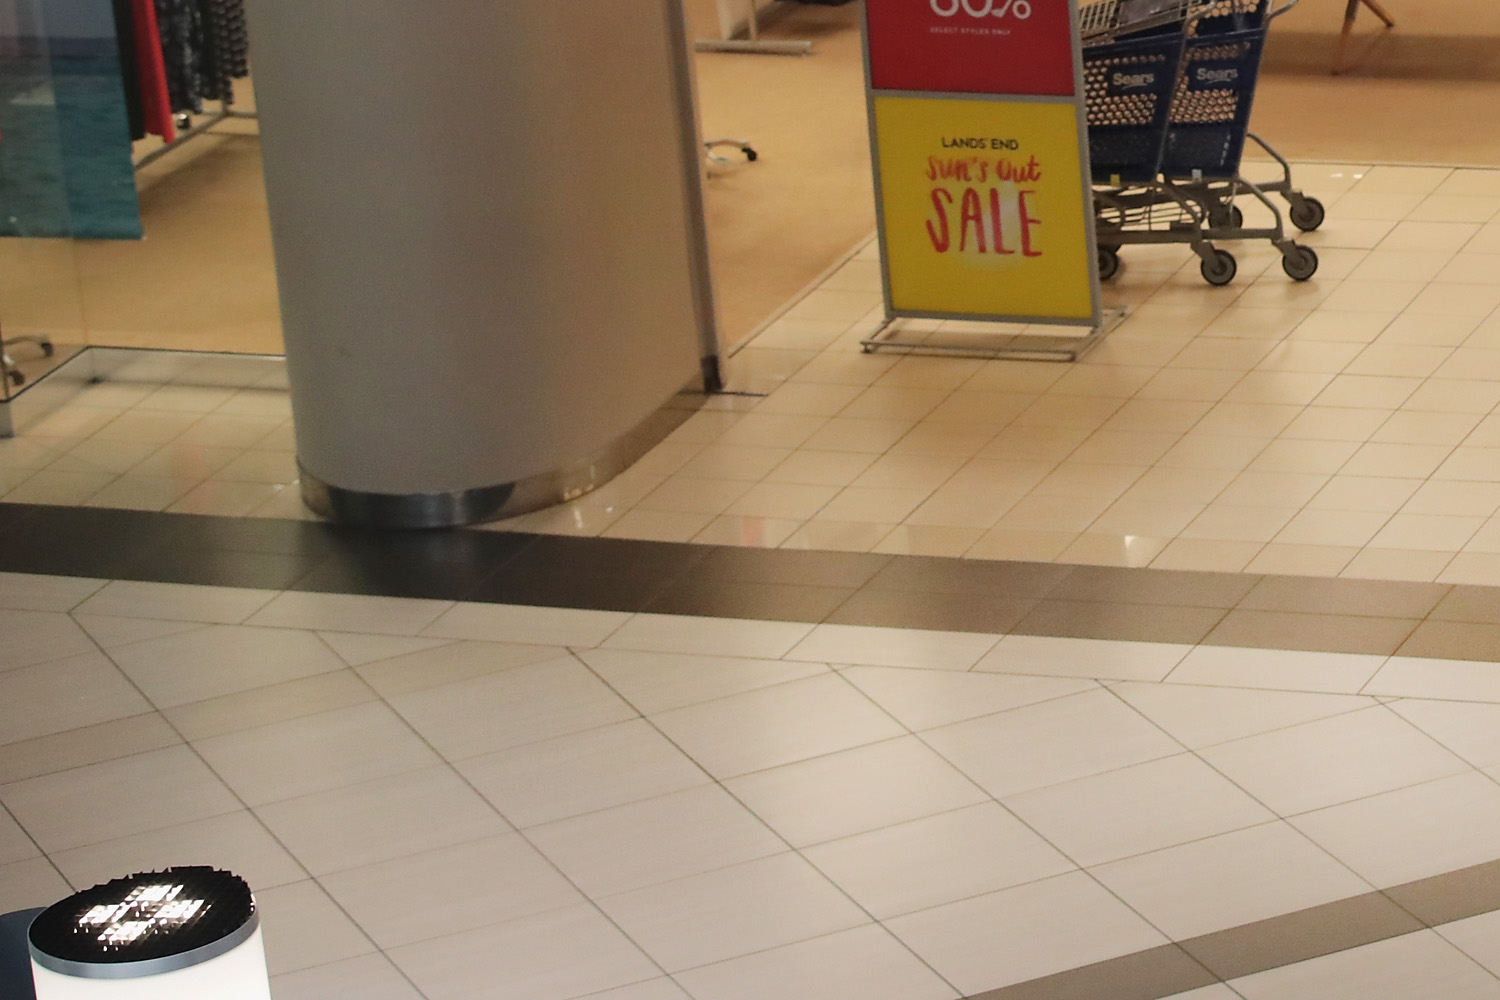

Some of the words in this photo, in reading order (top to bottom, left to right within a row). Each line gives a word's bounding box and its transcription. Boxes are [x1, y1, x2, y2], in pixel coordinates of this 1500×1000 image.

[1112, 72, 1155, 86] Sears
[1197, 67, 1239, 82] Sears
[991, 138, 1019, 150] END
[925, 187, 1043, 258] SALE
